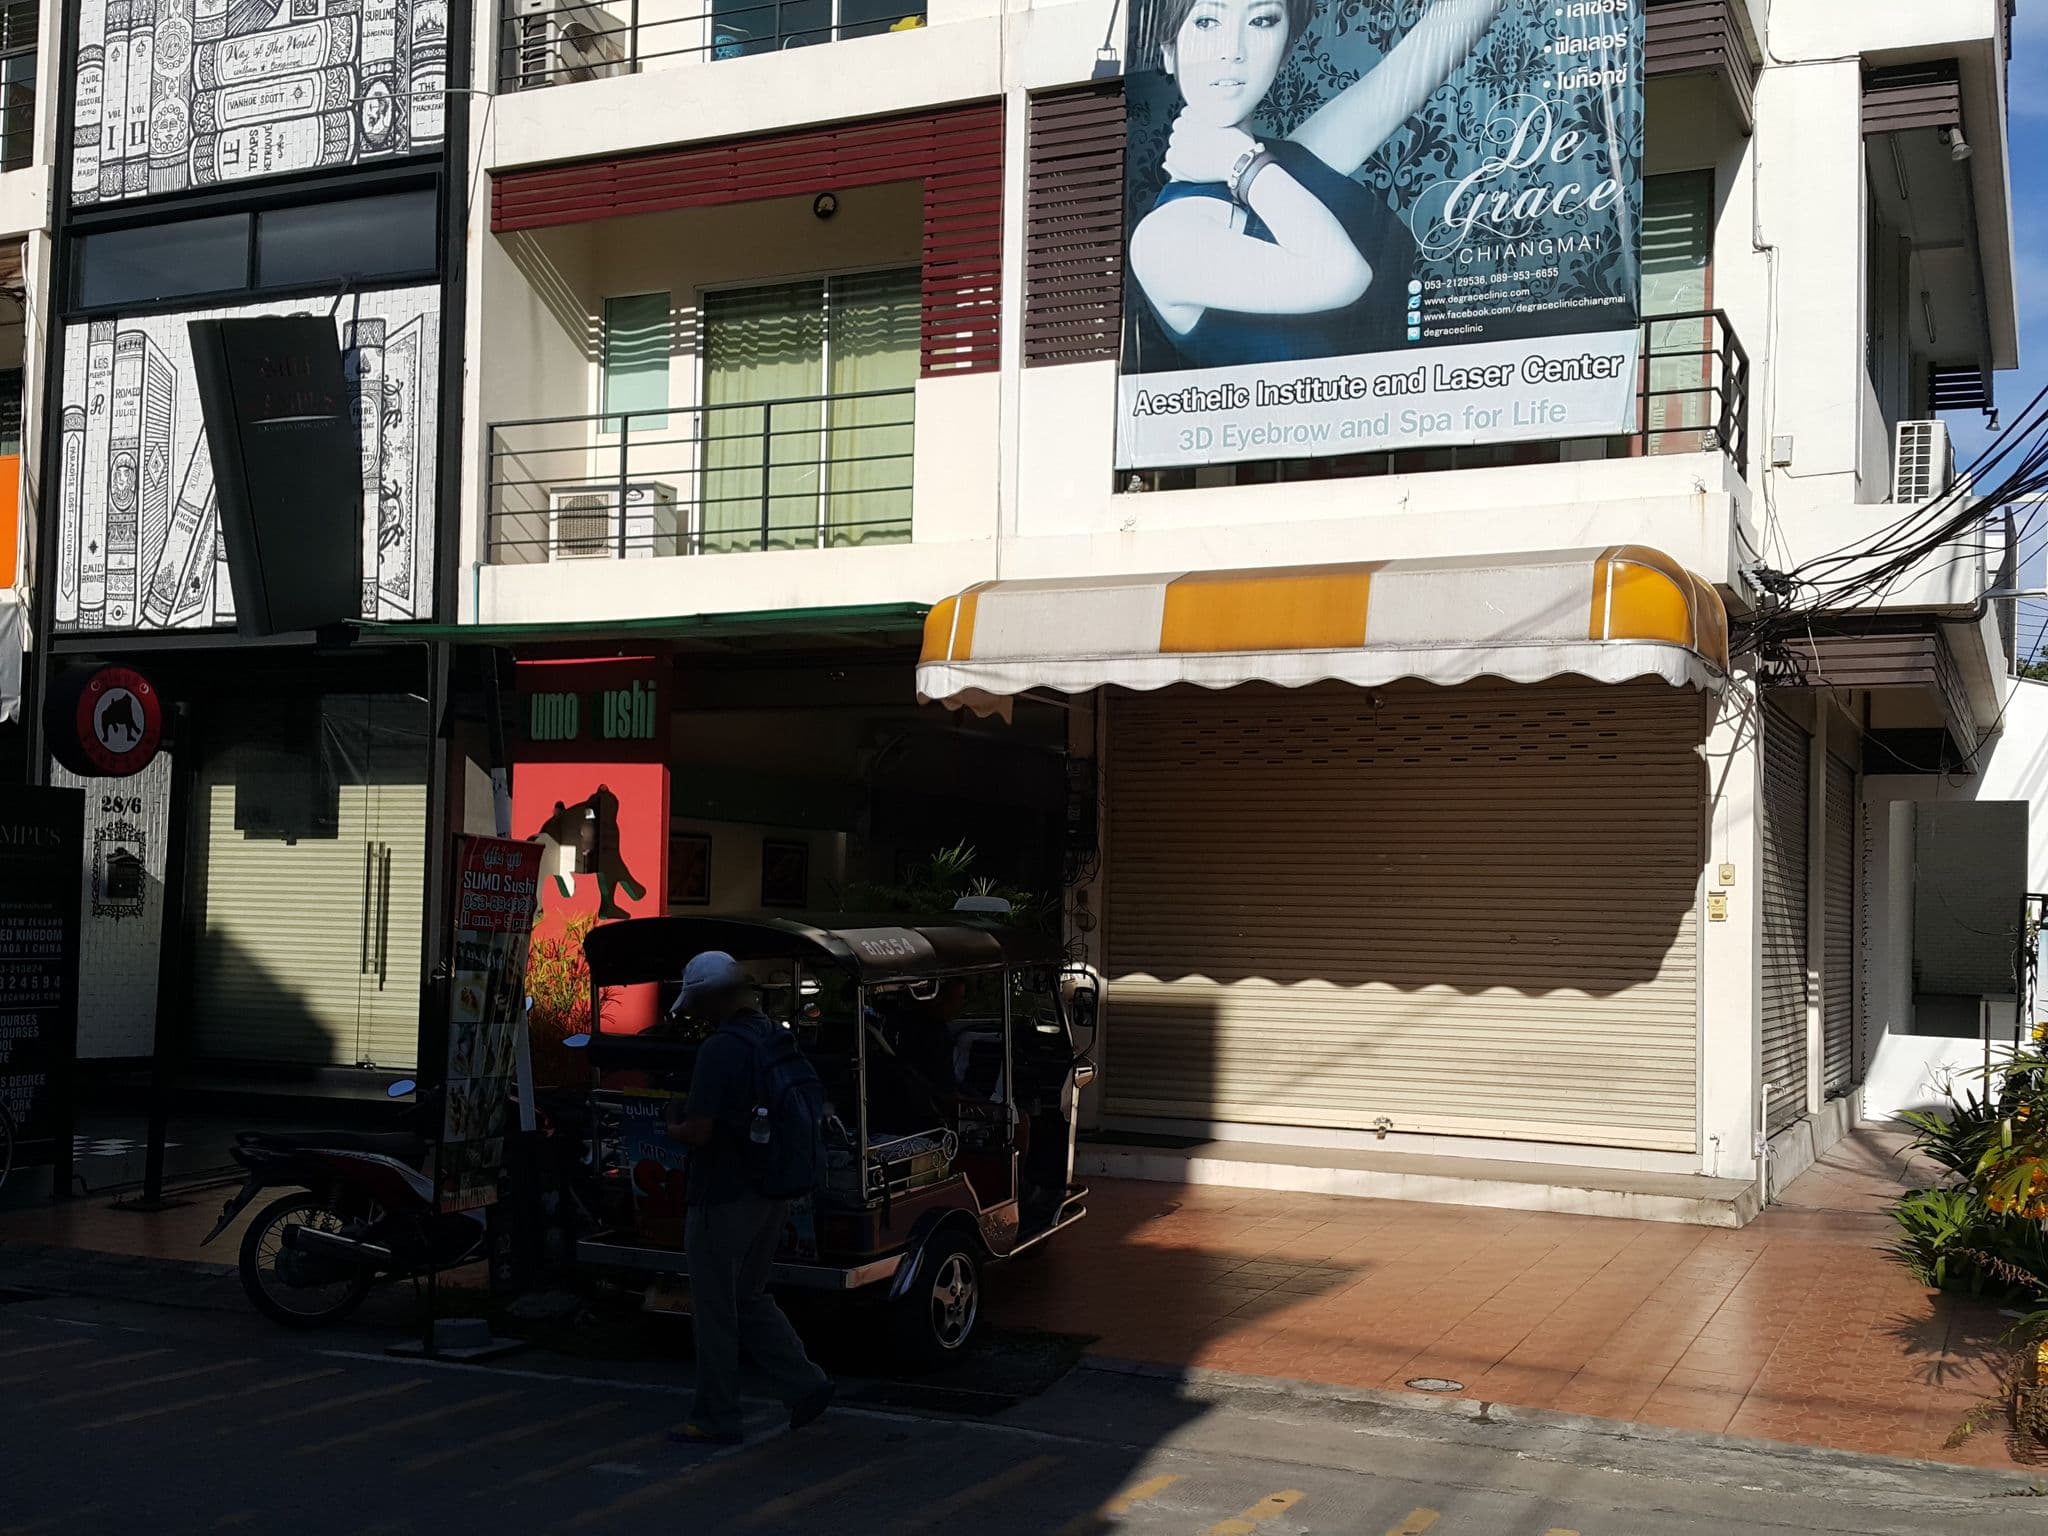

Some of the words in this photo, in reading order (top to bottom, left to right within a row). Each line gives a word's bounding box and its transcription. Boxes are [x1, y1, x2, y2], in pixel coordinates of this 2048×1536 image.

[365, 8, 395, 21] SUBLIME
[1567, 0, 1628, 18] เลเซอร
[286, 34, 317, 51] World
[1555, 26, 1629, 55] ฟิลเลอร์
[81, 74, 100, 85] JUDE
[418, 81, 436, 91] THE
[131, 105, 146, 115] VOL
[227, 97, 257, 110] IVANHOE
[260, 92, 285, 104] SCOTT
[107, 110, 122, 120] VOL
[108, 125, 116, 150] I
[1480, 94, 1587, 171] De
[223, 139, 240, 166] LE
[249, 129, 259, 171] TEMPS
[1459, 234, 1601, 264] CHIANGMAI
[1490, 266, 1559, 284] 089-953-6655
[1424, 287, 1530, 306] www.degraceclinic.com
[1423, 293, 1626, 322] www.facebook.com/degraceclinicchiangmai
[1423, 323, 1484, 338] degraceclinic
[93, 357, 109, 369] LES
[1256, 374, 1367, 407] Institute
[1373, 366, 1426, 397] and
[1433, 362, 1515, 393] Laser
[1521, 352, 1625, 384] Center
[115, 387, 141, 399] ROMEO
[115, 408, 137, 418] JULIET
[1178, 426, 1213, 451] 3D
[1223, 420, 1331, 451] Eyebrow
[1340, 412, 1389, 438] and
[1399, 408, 1452, 438] Spa
[1462, 404, 1502, 430] for
[1513, 398, 1567, 426] Life
[67, 491, 75, 513] LOST
[176, 510, 197, 525] VICTOR
[83, 563, 105, 573] EMILY
[102, 796, 141, 815] 28/6
[463, 870, 500, 892] SUMO
[503, 874, 536, 894] Sushi
[16, 928, 62, 941] KINGDOM
[32, 943, 62, 953] CHINA
